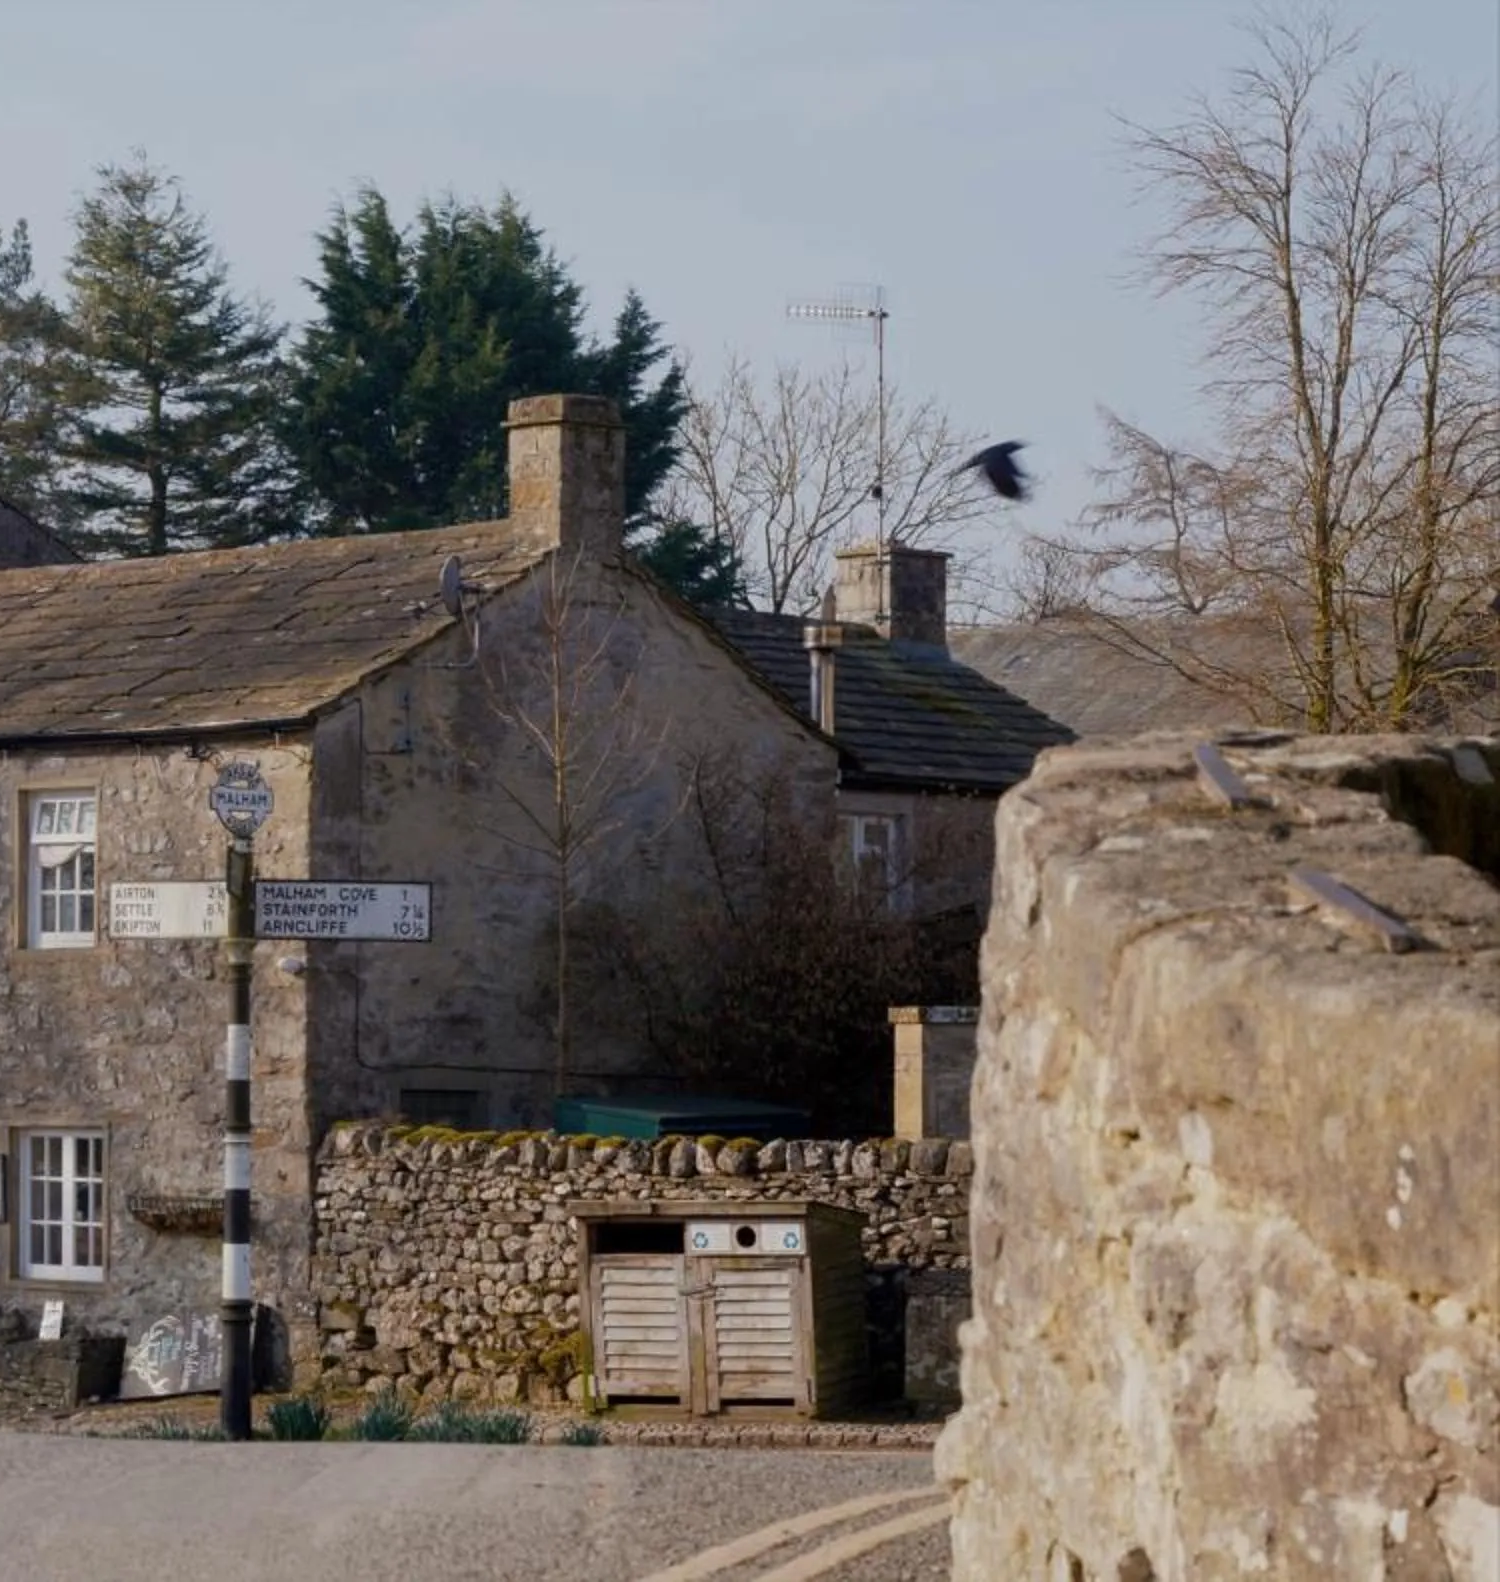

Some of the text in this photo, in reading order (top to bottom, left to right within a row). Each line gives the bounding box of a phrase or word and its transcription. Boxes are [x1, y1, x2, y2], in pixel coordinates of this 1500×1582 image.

[217, 792, 268, 808] MALHAM
[262, 887, 327, 900] MALHAM
[339, 887, 378, 901] COVE
[262, 903, 359, 917] STAINFORTH
[263, 919, 349, 934] ARNCLIFFE
